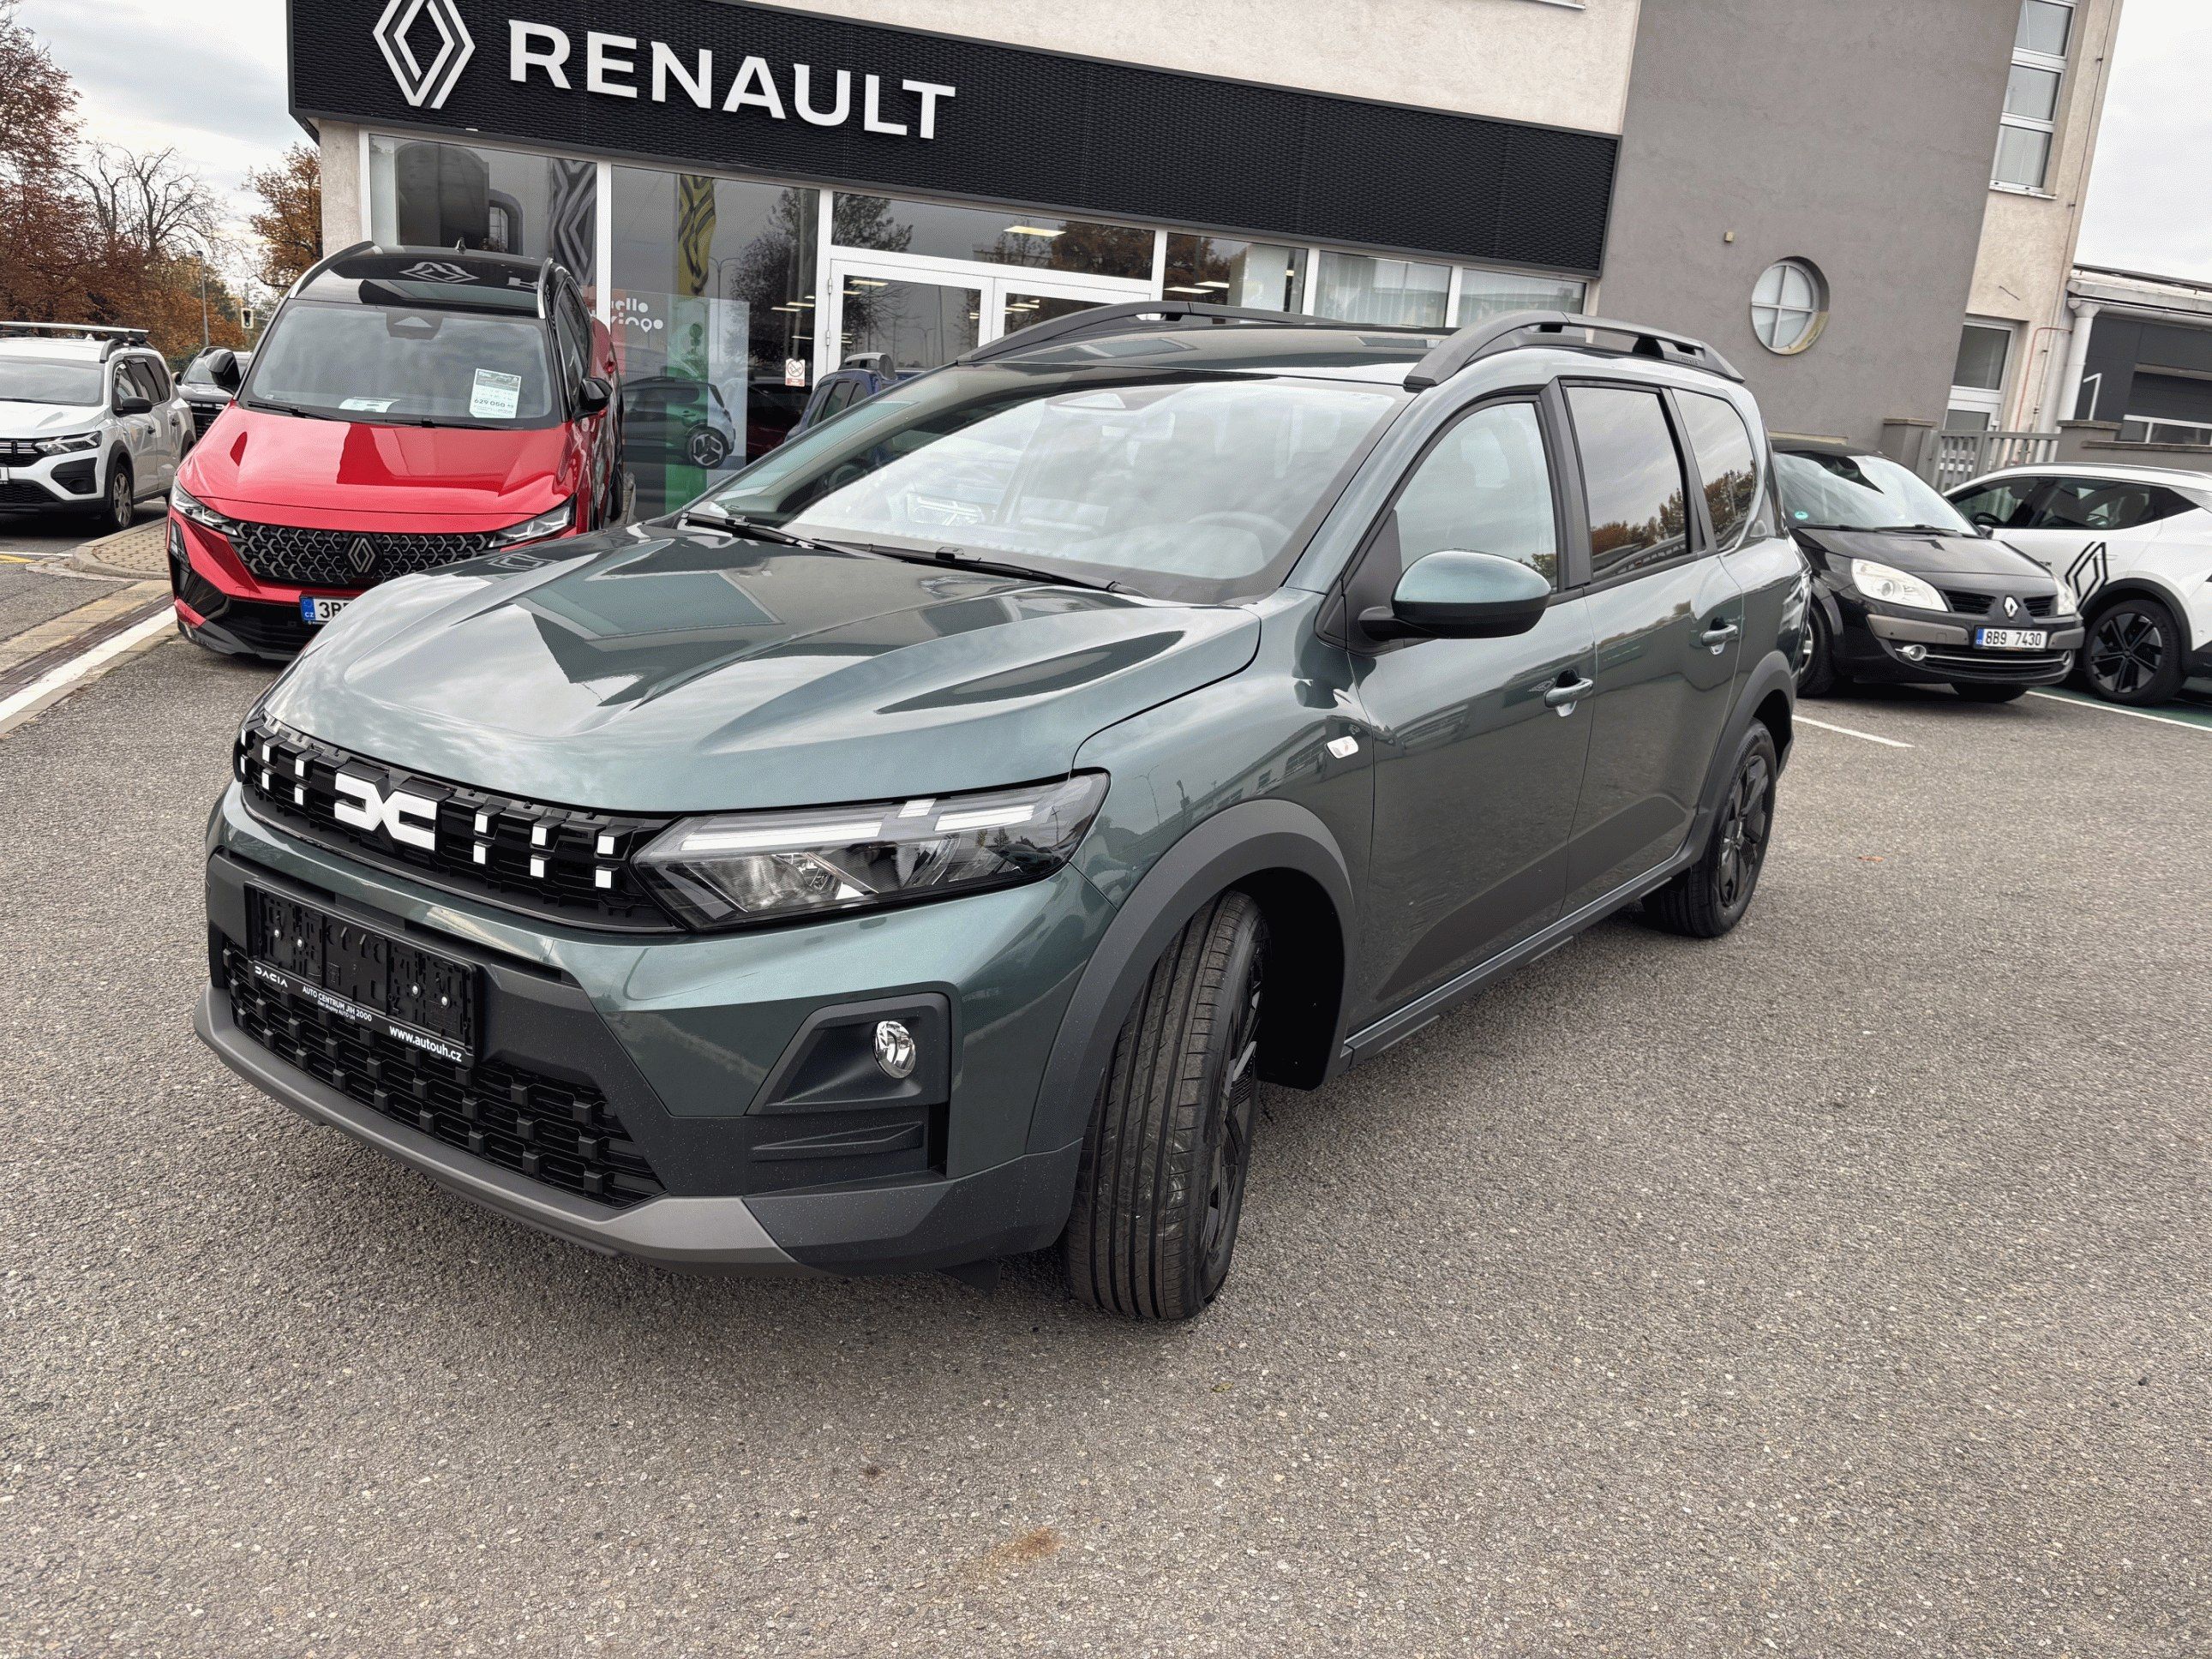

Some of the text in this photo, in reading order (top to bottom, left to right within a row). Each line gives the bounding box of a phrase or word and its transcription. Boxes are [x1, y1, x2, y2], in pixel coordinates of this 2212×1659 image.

[508, 19, 956, 140] RENAULT
[1986, 631, 2007, 644] 8B9
[2015, 632, 2041, 645] 7430
[255, 966, 288, 987] DACIA
[303, 985, 372, 1021] AUTO CENTRUM JIH 2000
[389, 1026, 462, 1062] www.autouh.cz
